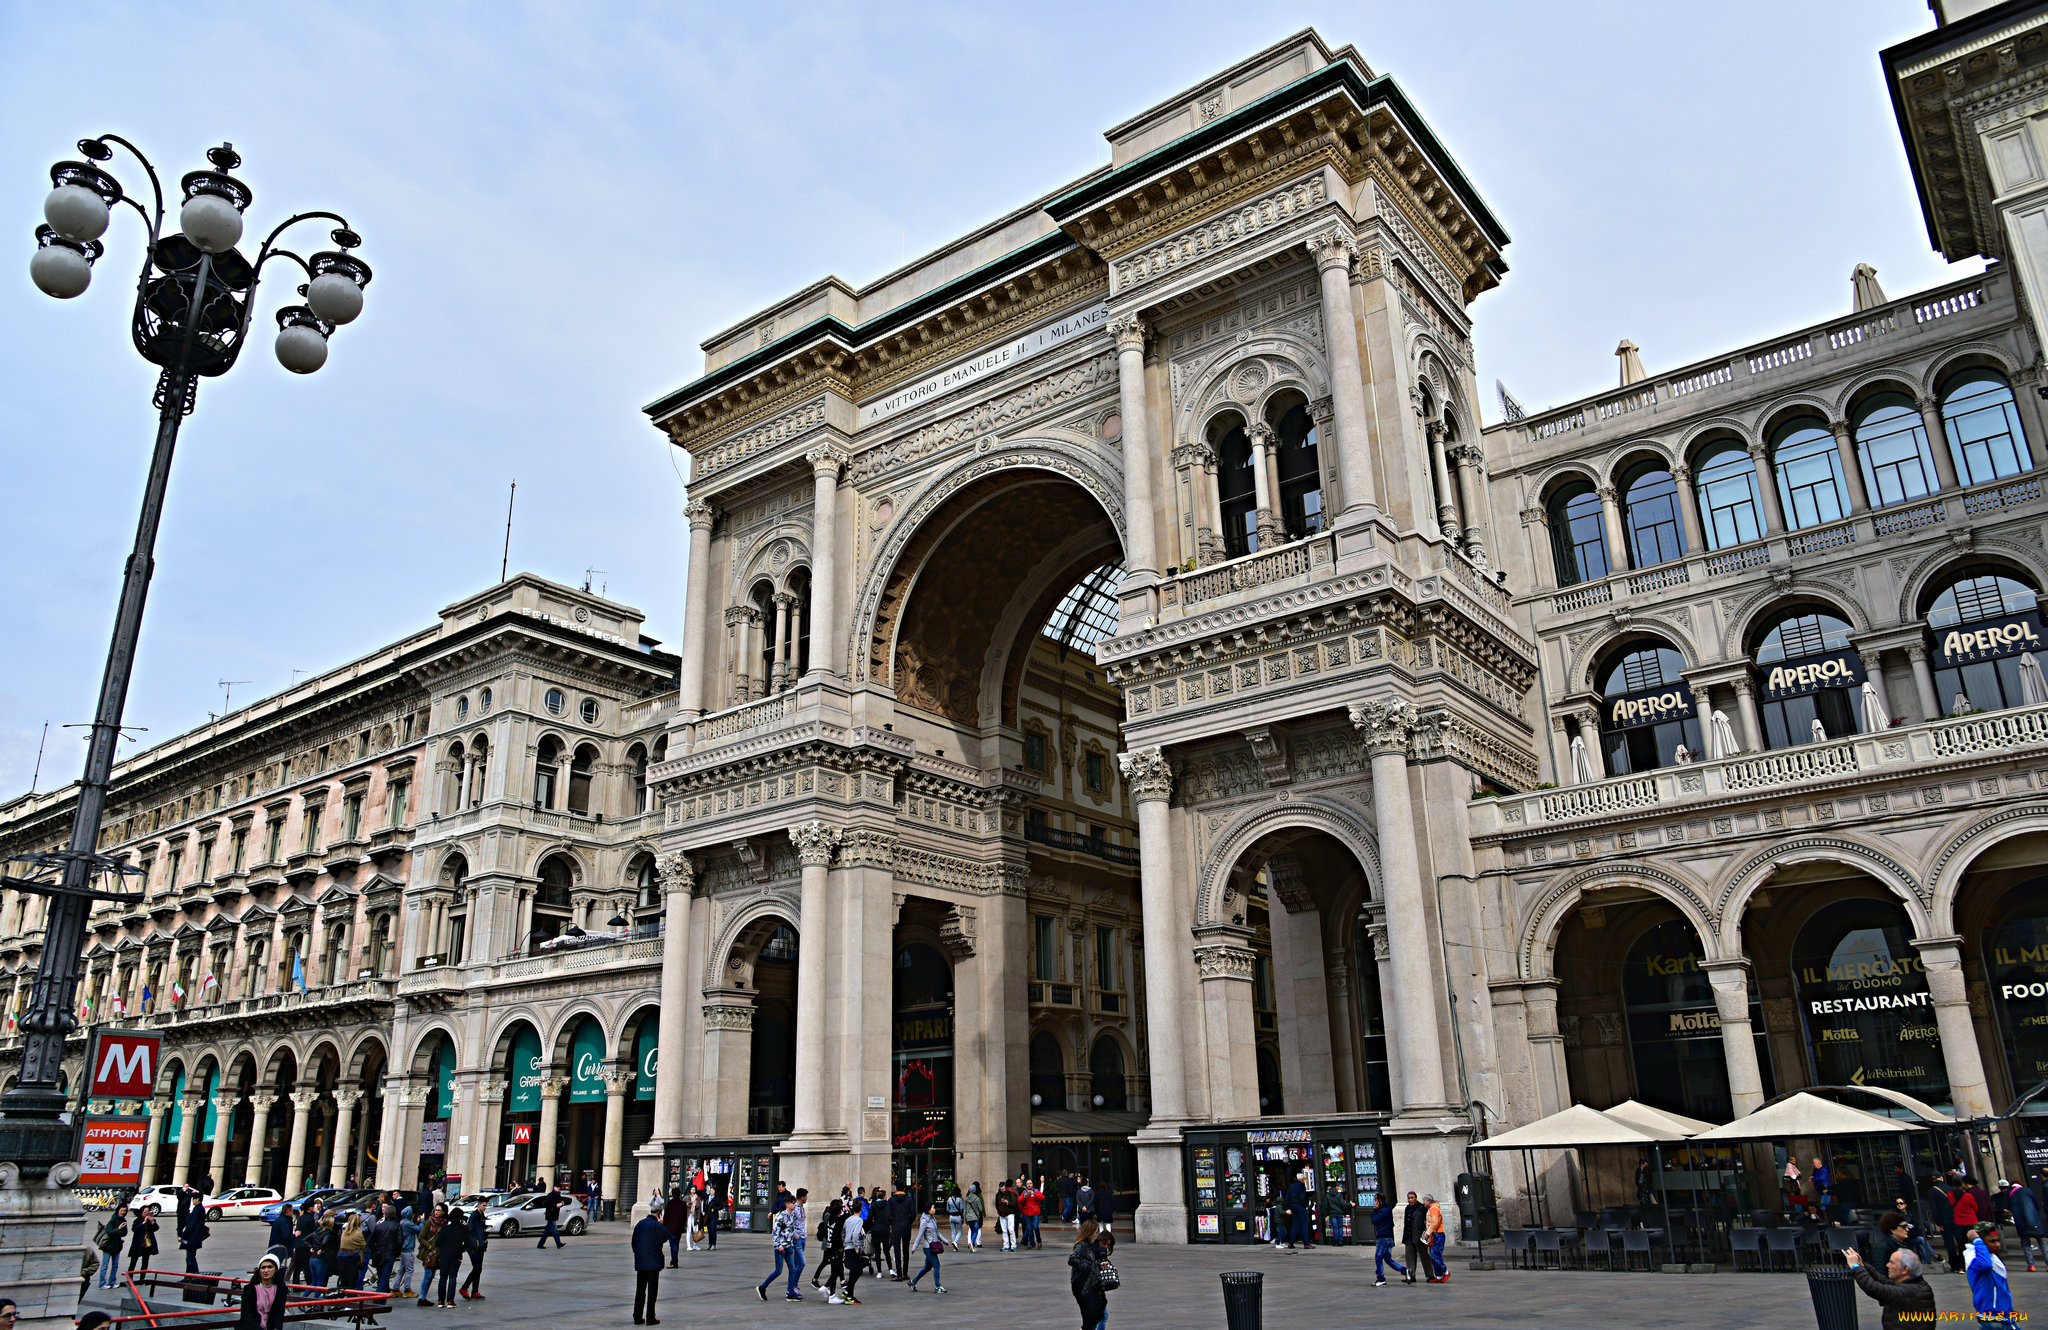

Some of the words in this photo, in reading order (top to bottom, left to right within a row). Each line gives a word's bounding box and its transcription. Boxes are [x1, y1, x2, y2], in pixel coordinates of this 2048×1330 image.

[871, 408, 878, 418] A
[885, 382, 937, 411] VITTORIO
[944, 351, 1010, 386] EMANUELE
[1051, 308, 1109, 341] MILANES
[1944, 620, 2038, 657] APEROL
[1945, 640, 2042, 665] TERRAZZA
[1769, 657, 1853, 691] APEROL
[1769, 675, 1855, 697] TERRAZZA
[1612, 690, 1689, 722] APEROL
[1613, 707, 1690, 729] TERRAZZA
[1995, 948, 2016, 965] IL
[1802, 967, 1822, 984] IL
[1826, 956, 1927, 982] MERCATO
[1852, 977, 1901, 990] DUOMO
[1669, 1011, 1721, 1031] Motta
[1822, 1028, 1859, 1041] Motta
[97, 1043, 151, 1084] M
[86, 1129, 112, 1138] ATM
[111, 1129, 146, 1138] POINT
[516, 1128, 529, 1139] M
